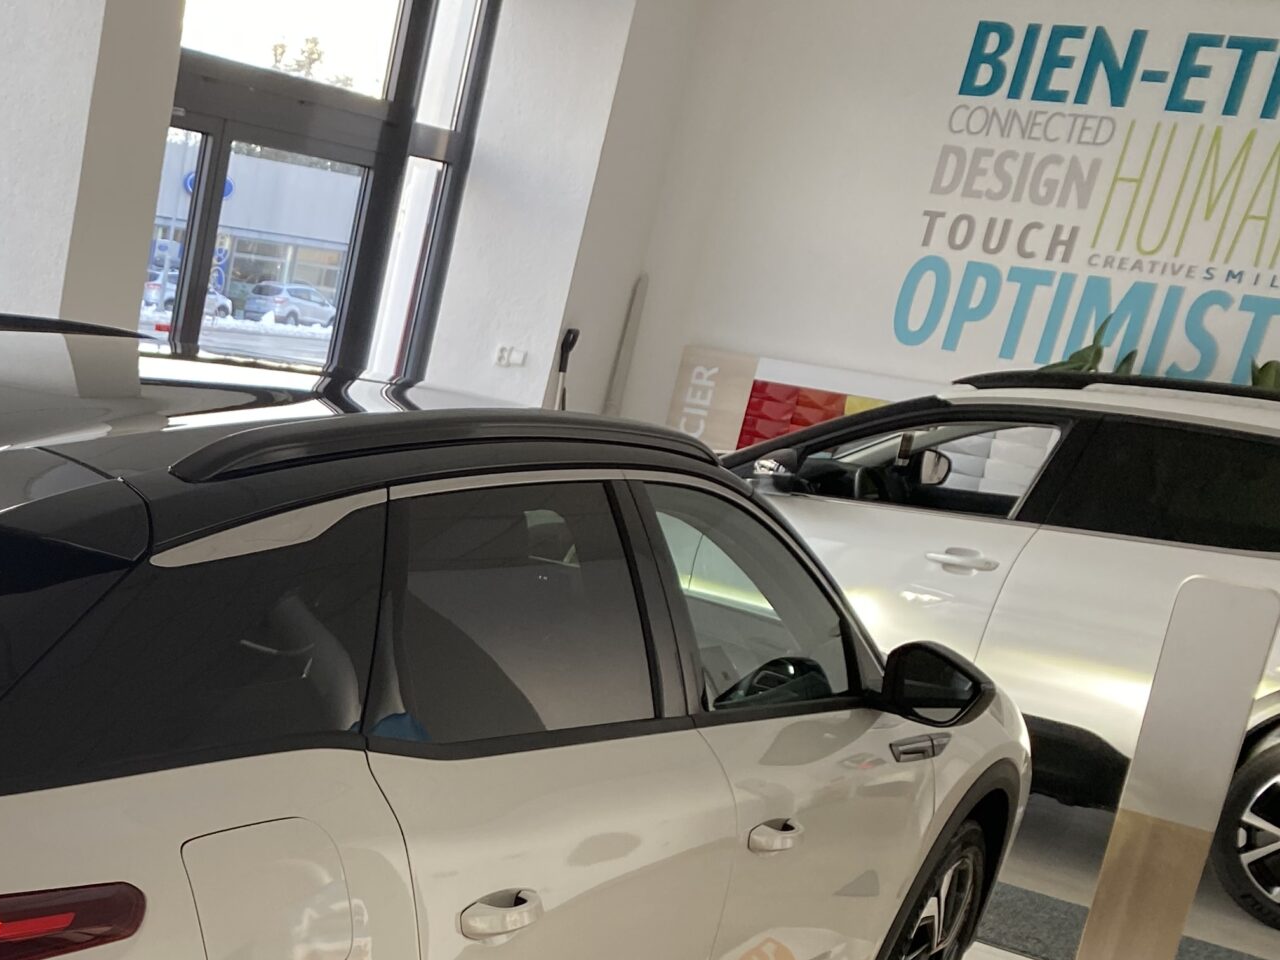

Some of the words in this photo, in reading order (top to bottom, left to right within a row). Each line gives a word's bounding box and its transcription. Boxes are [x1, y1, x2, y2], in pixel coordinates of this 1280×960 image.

[948, 103, 1116, 146] CONNECTED
[929, 144, 1103, 210] DESIGN
[1090, 119, 1280, 270] HUMA
[921, 209, 1080, 264] TOUCH
[1087, 253, 1198, 279] CREATIVE
[1202, 266, 1280, 288] SMIL
